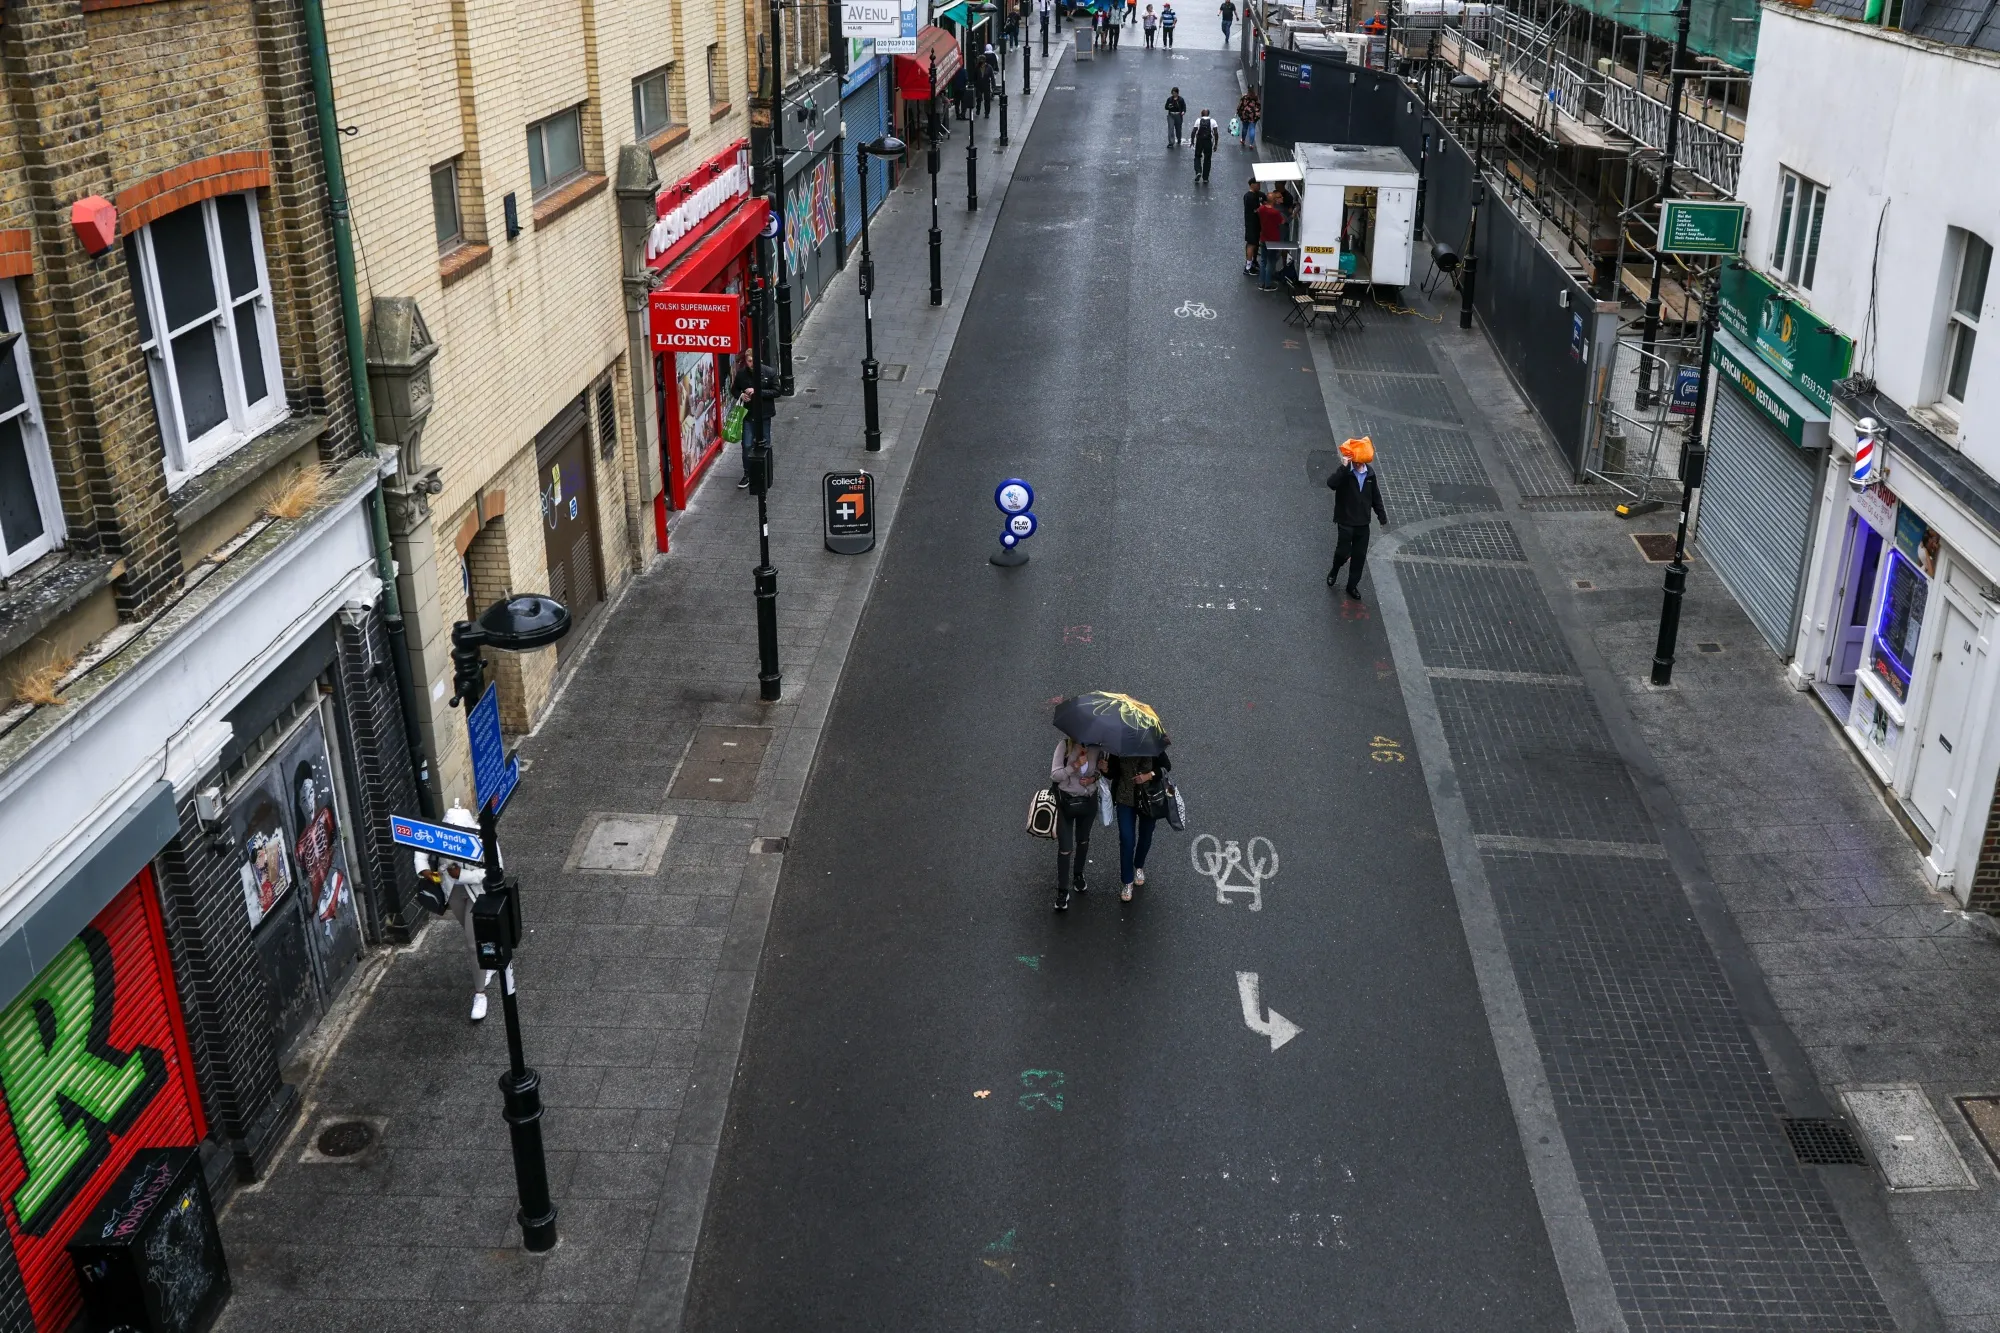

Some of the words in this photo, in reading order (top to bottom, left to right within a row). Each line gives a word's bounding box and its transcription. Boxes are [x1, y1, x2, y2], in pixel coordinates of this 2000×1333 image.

[848, 6, 888, 20] AVENU
[681, 303, 730, 312] SUPERMARKET
[675, 318, 710, 330] OFF
[656, 334, 731, 347] LICENCE
[1721, 355, 1741, 383] AFRICAN
[1742, 373, 1756, 395] FOOD
[1756, 386, 1790, 428] RESTAURANT
[396, 825, 412, 836] 232
[435, 830, 467, 844] Wandle
[442, 842, 462, 852] Park
